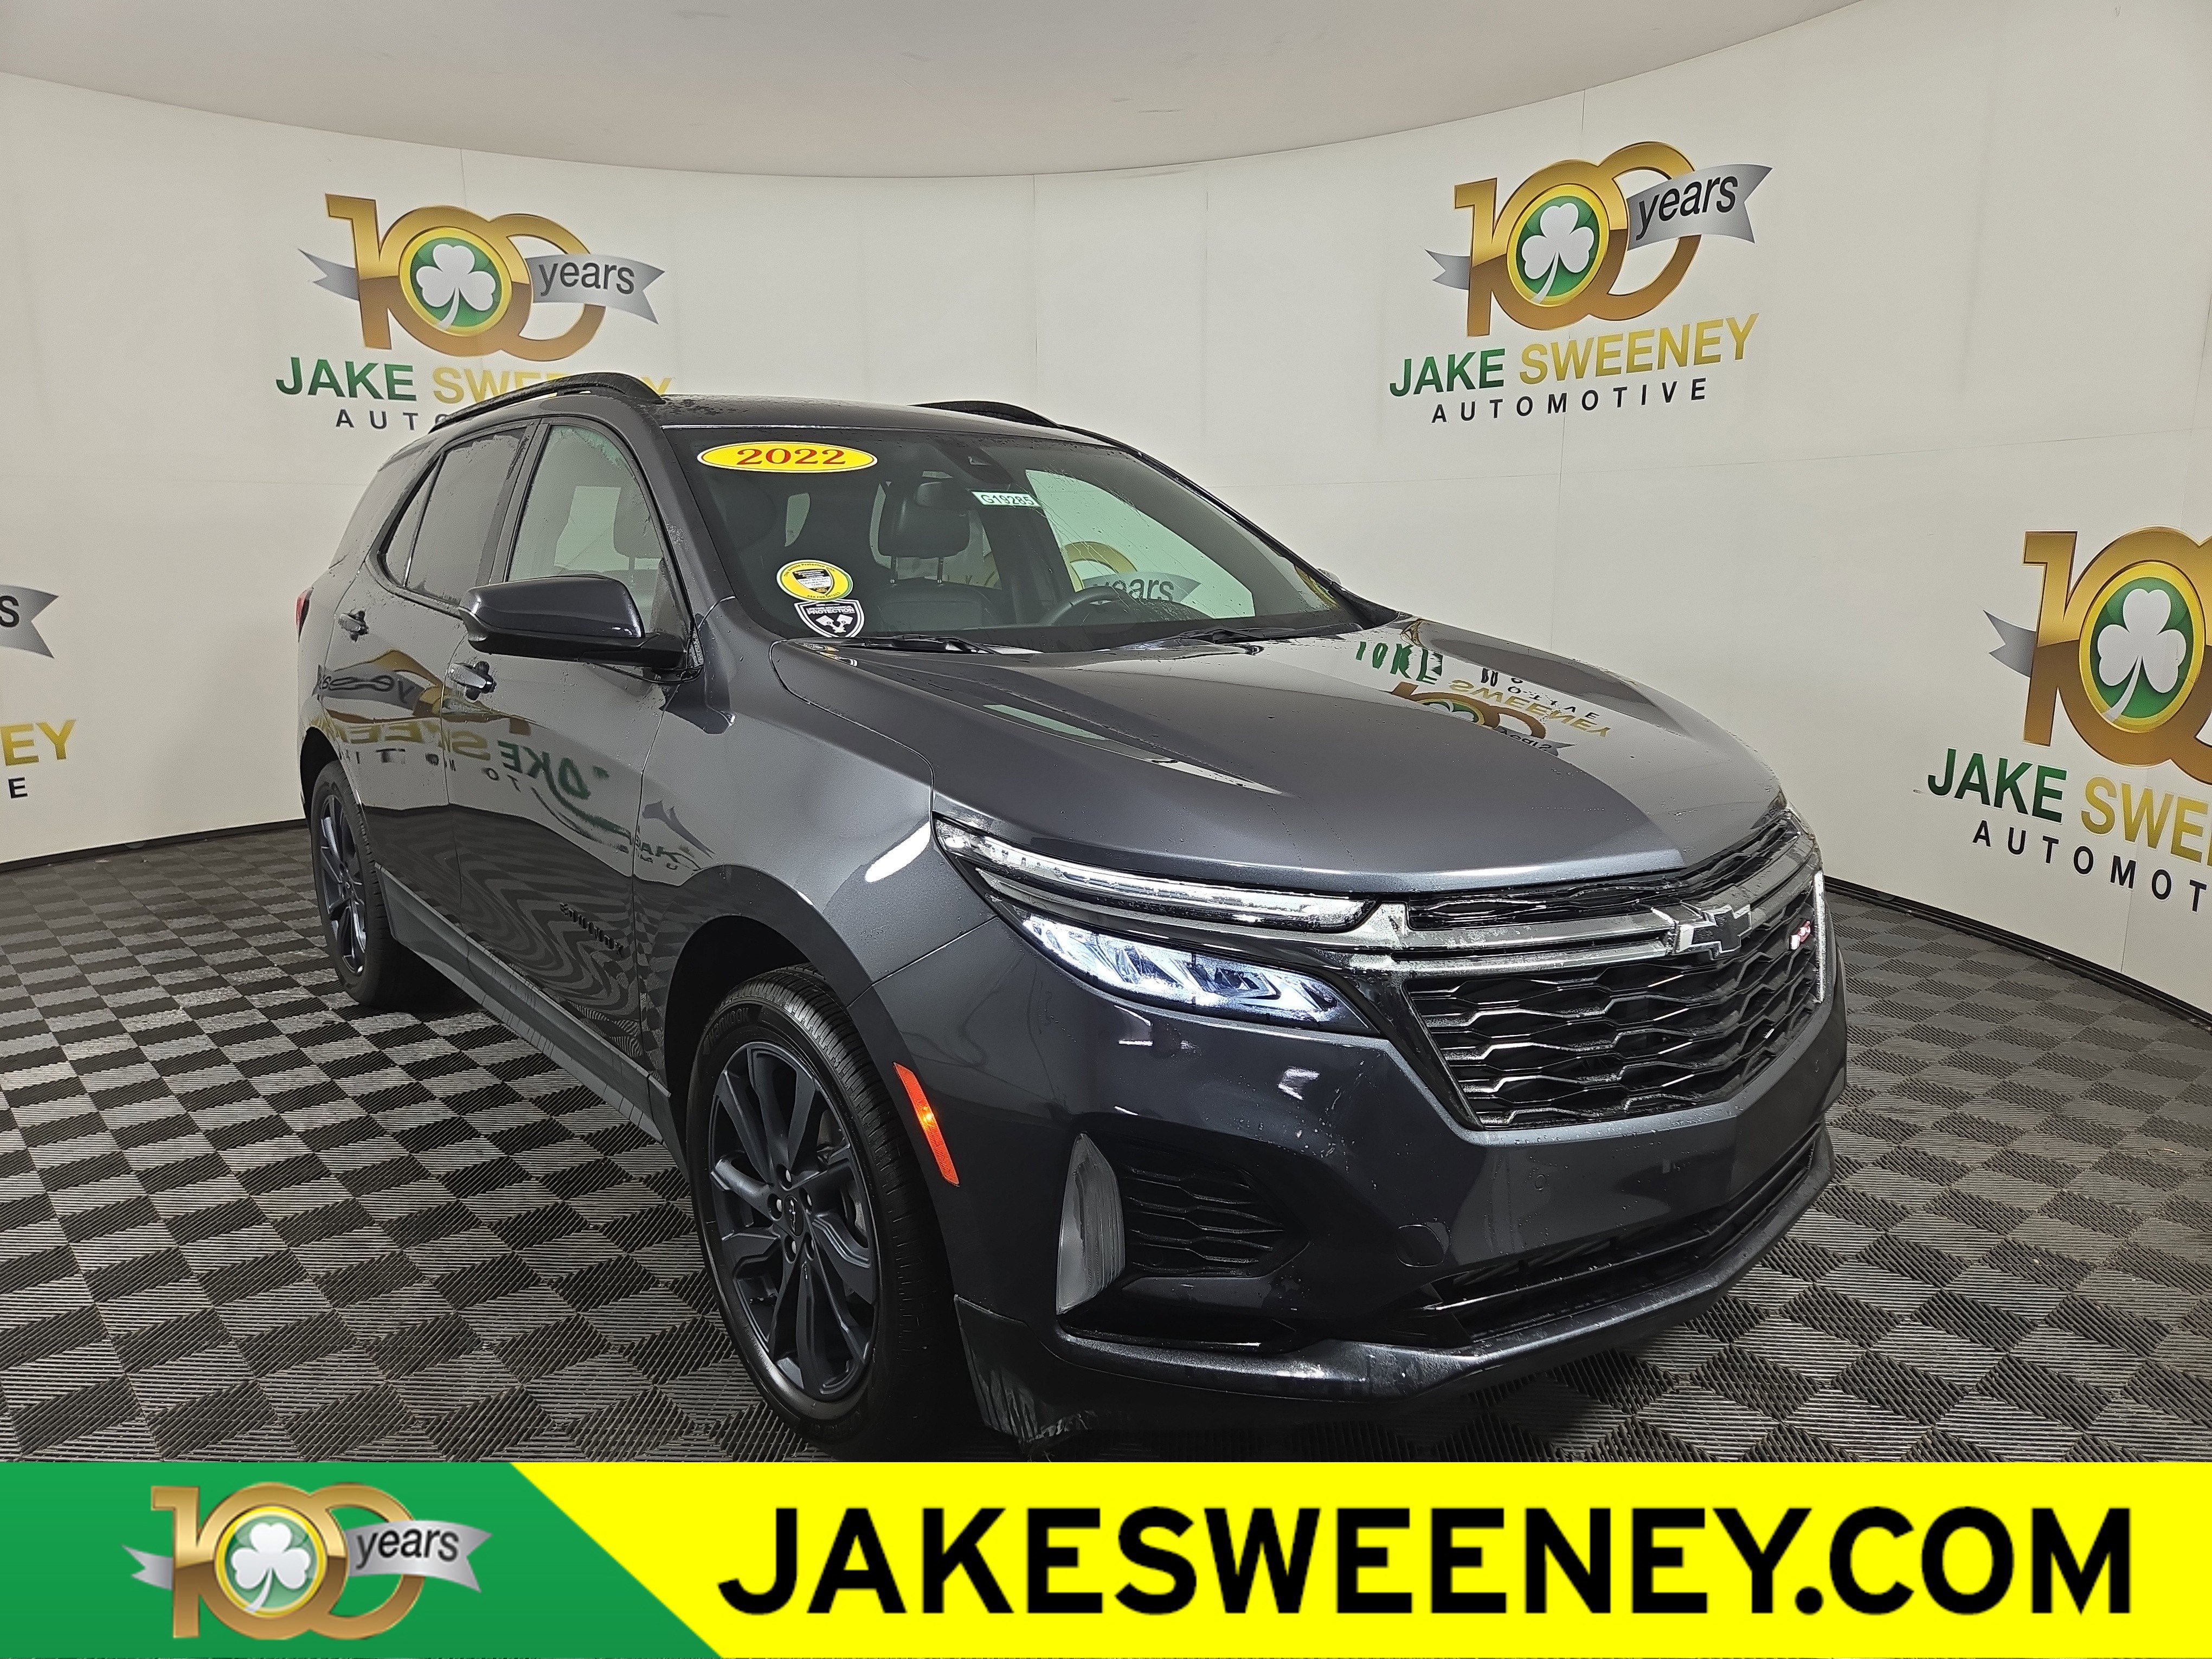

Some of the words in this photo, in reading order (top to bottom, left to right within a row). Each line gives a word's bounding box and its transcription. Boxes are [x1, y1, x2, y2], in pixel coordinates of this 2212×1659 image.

[325, 193, 606, 362] 100
[538, 261, 635, 297] years
[1454, 141, 1702, 337] 100
[1636, 176, 1738, 241] years
[276, 356, 417, 402] JAKE
[1390, 348, 1506, 397] JAKE
[1519, 313, 1759, 385] SWEENEY
[1431, 377, 1707, 424] AUTOMOTIVE
[736, 448, 846, 465] 2022
[981, 494, 1034, 505] G19285
[2023, 526, 2212, 786] 10
[1927, 748, 2067, 825] JAKE
[2081, 776, 2212, 867] SWE
[1972, 820, 2208, 913] AUTOMOT
